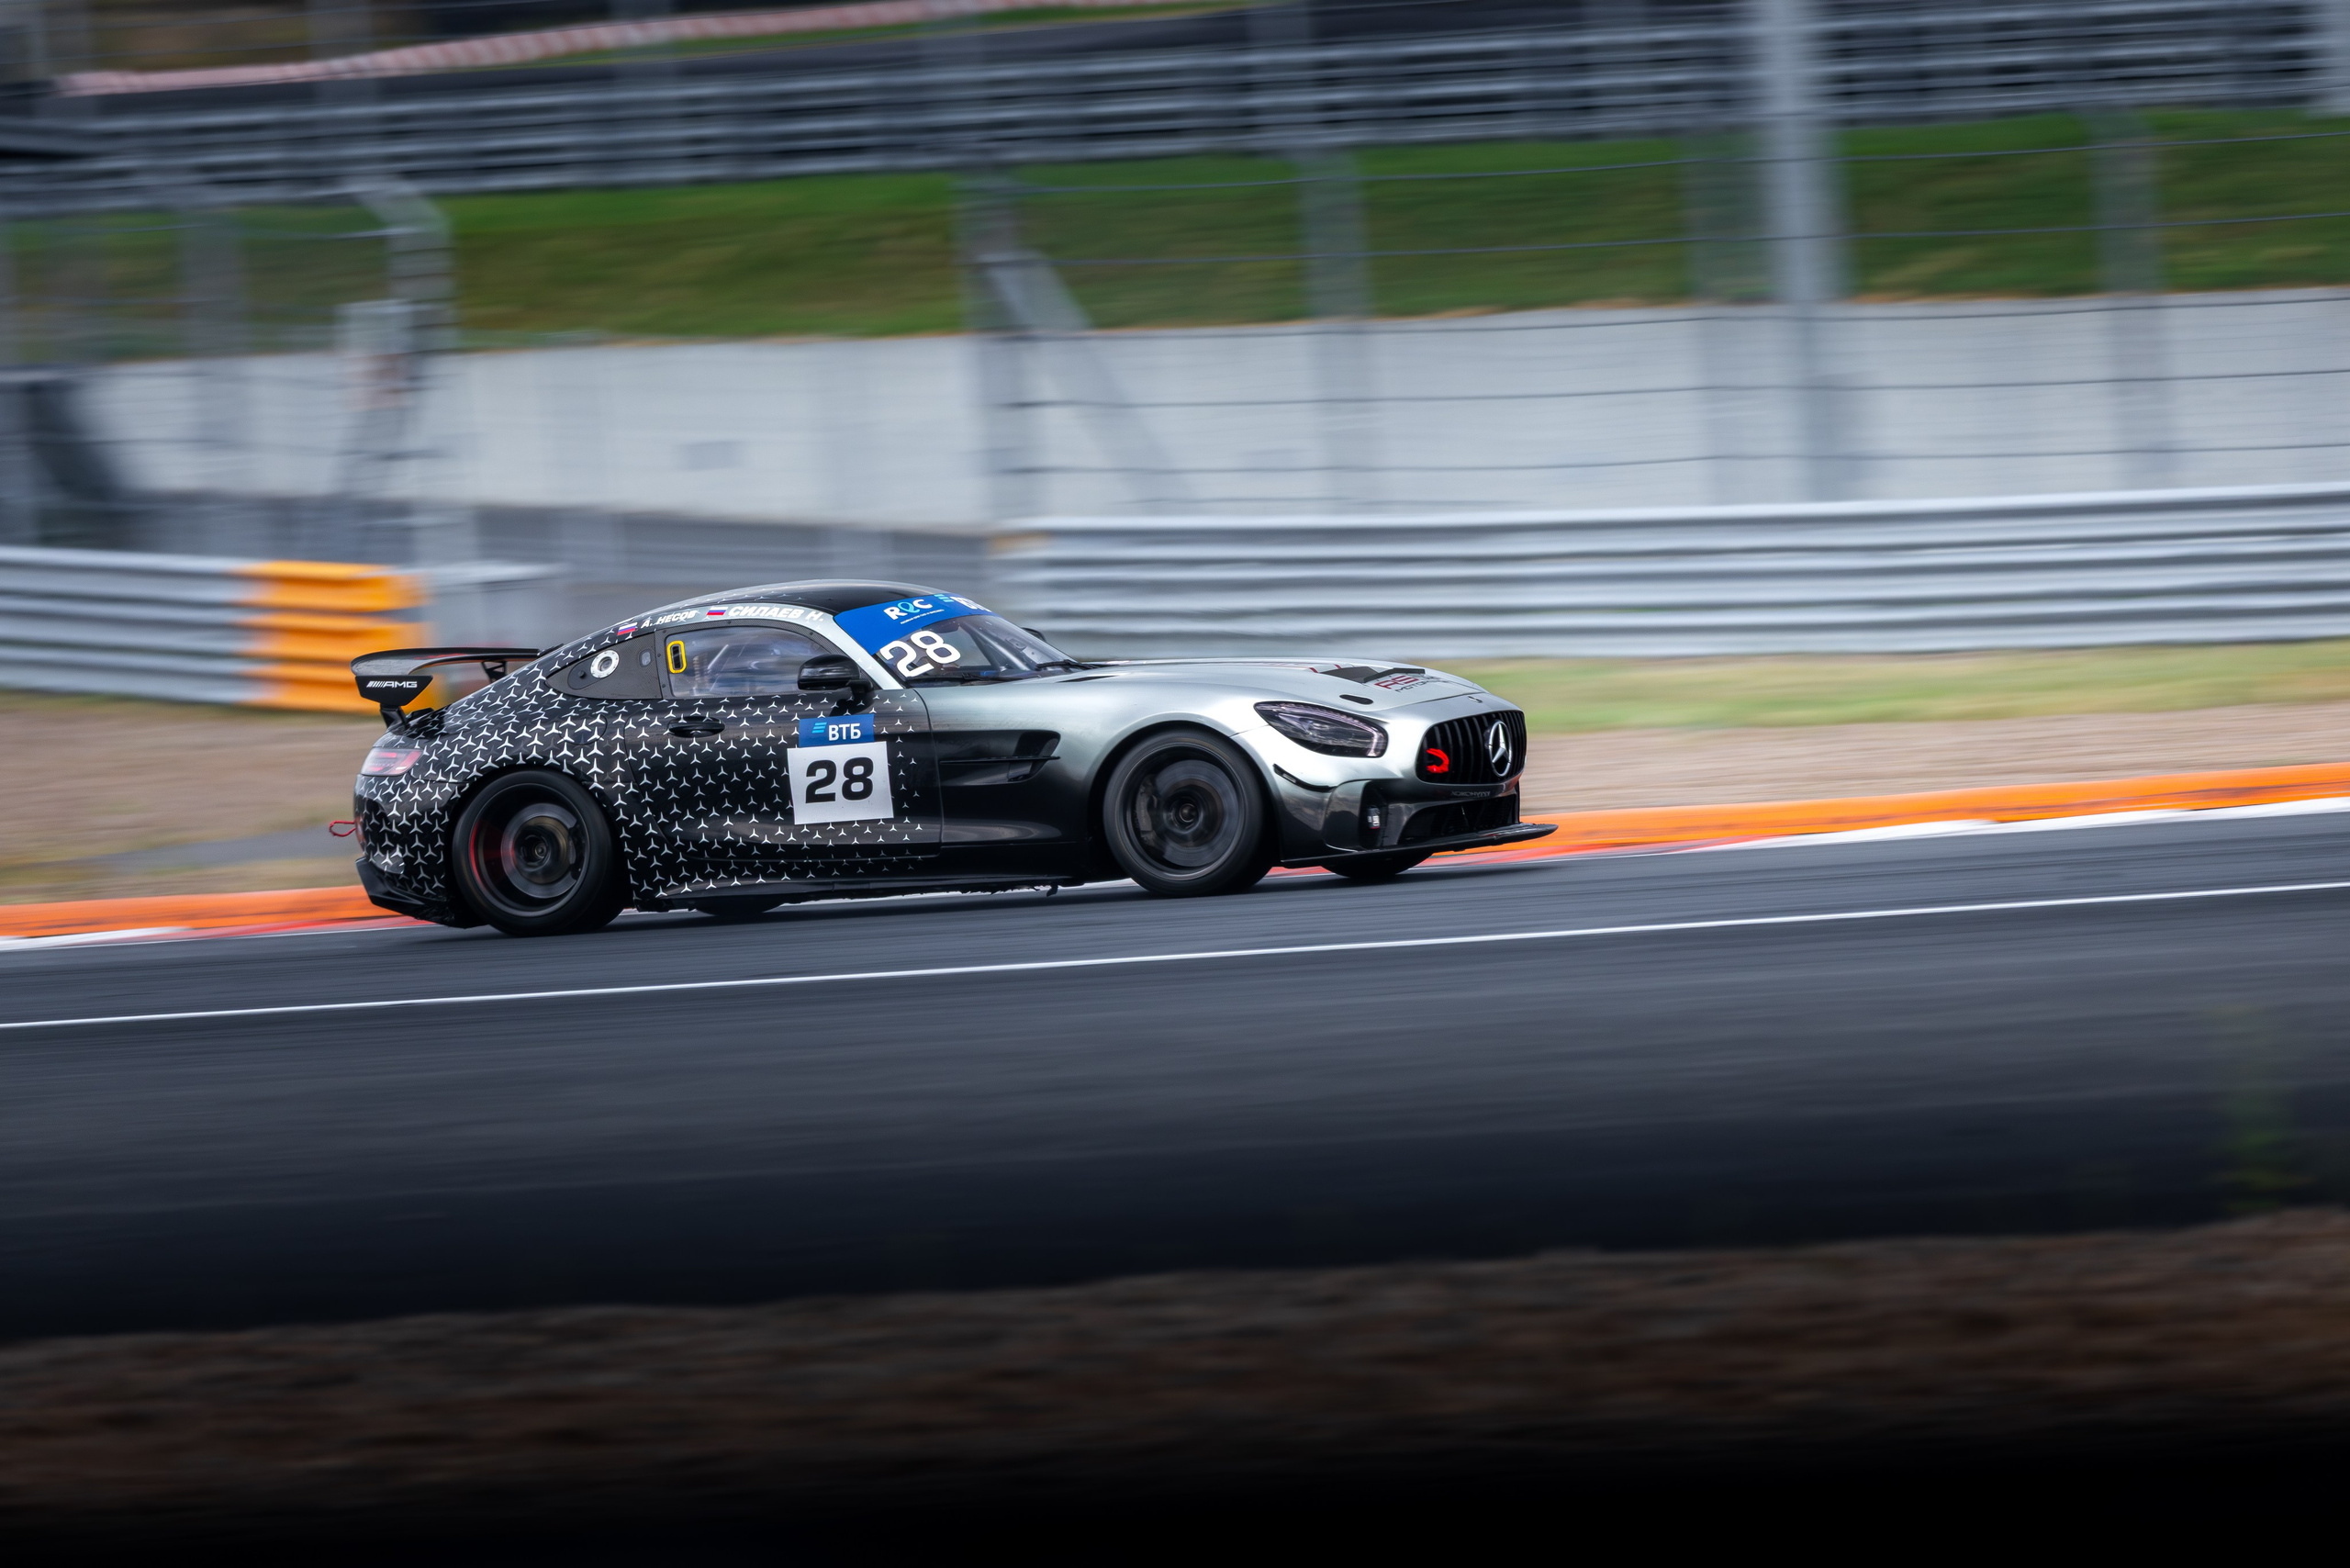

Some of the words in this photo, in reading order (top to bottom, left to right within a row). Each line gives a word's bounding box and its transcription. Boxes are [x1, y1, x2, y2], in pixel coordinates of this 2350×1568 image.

[728, 605, 805, 619] СИЛАЕВ
[879, 630, 961, 678] 28
[383, 680, 418, 689] AMG
[828, 722, 862, 742] ВТБ
[805, 756, 874, 804] 28
